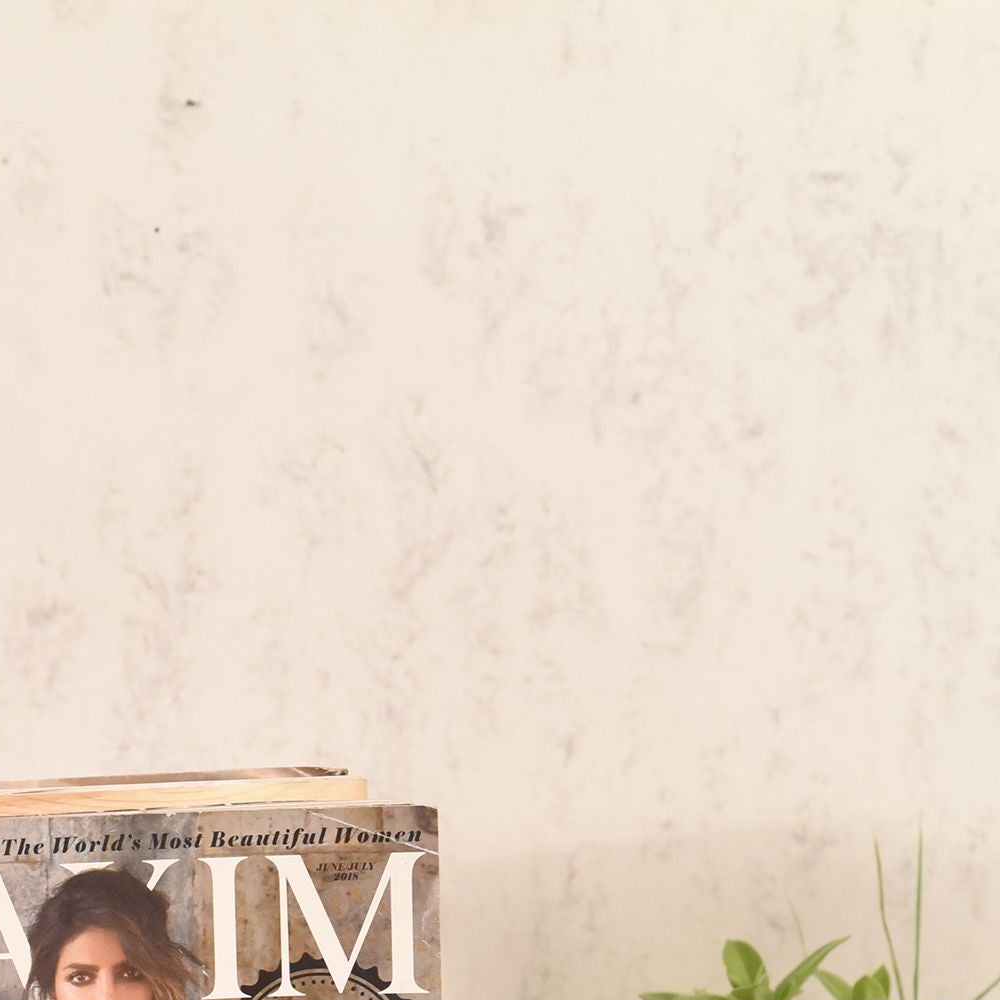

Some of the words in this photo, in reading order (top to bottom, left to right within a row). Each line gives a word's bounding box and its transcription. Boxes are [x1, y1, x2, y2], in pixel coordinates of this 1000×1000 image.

[2, 837, 45, 856] The
[52, 833, 142, 855] World's
[149, 830, 203, 850] Most
[210, 827, 327, 850] Beautiful
[335, 826, 423, 846] Women
[334, 872, 359, 881] 2018
